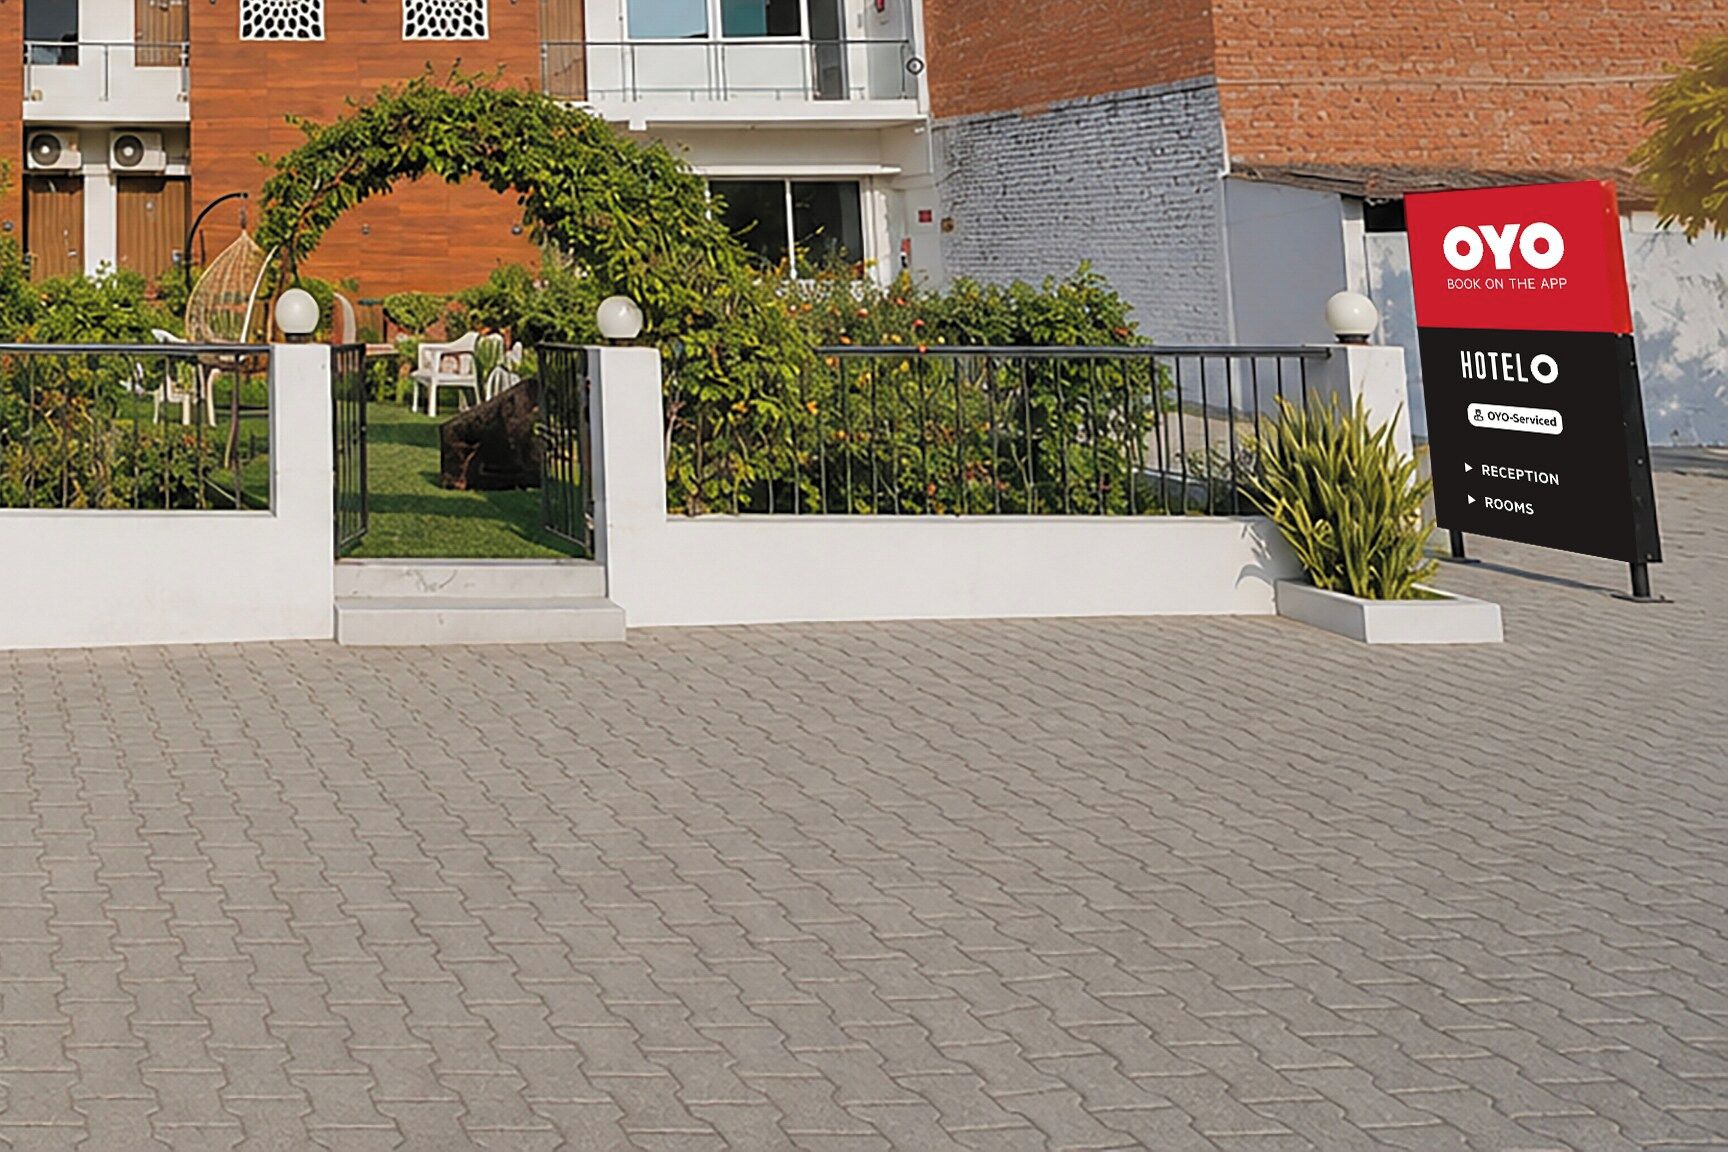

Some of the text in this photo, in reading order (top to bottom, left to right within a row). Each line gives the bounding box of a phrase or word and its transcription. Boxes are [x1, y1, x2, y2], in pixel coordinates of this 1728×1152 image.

[1443, 222, 1565, 271] OYO
[1447, 278, 1568, 290] BOOK ON THE APP
[1487, 411, 1557, 427] OYO-Serviced
[1481, 464, 1560, 486] RECEPTION
[1484, 496, 1535, 515] ROOMS
